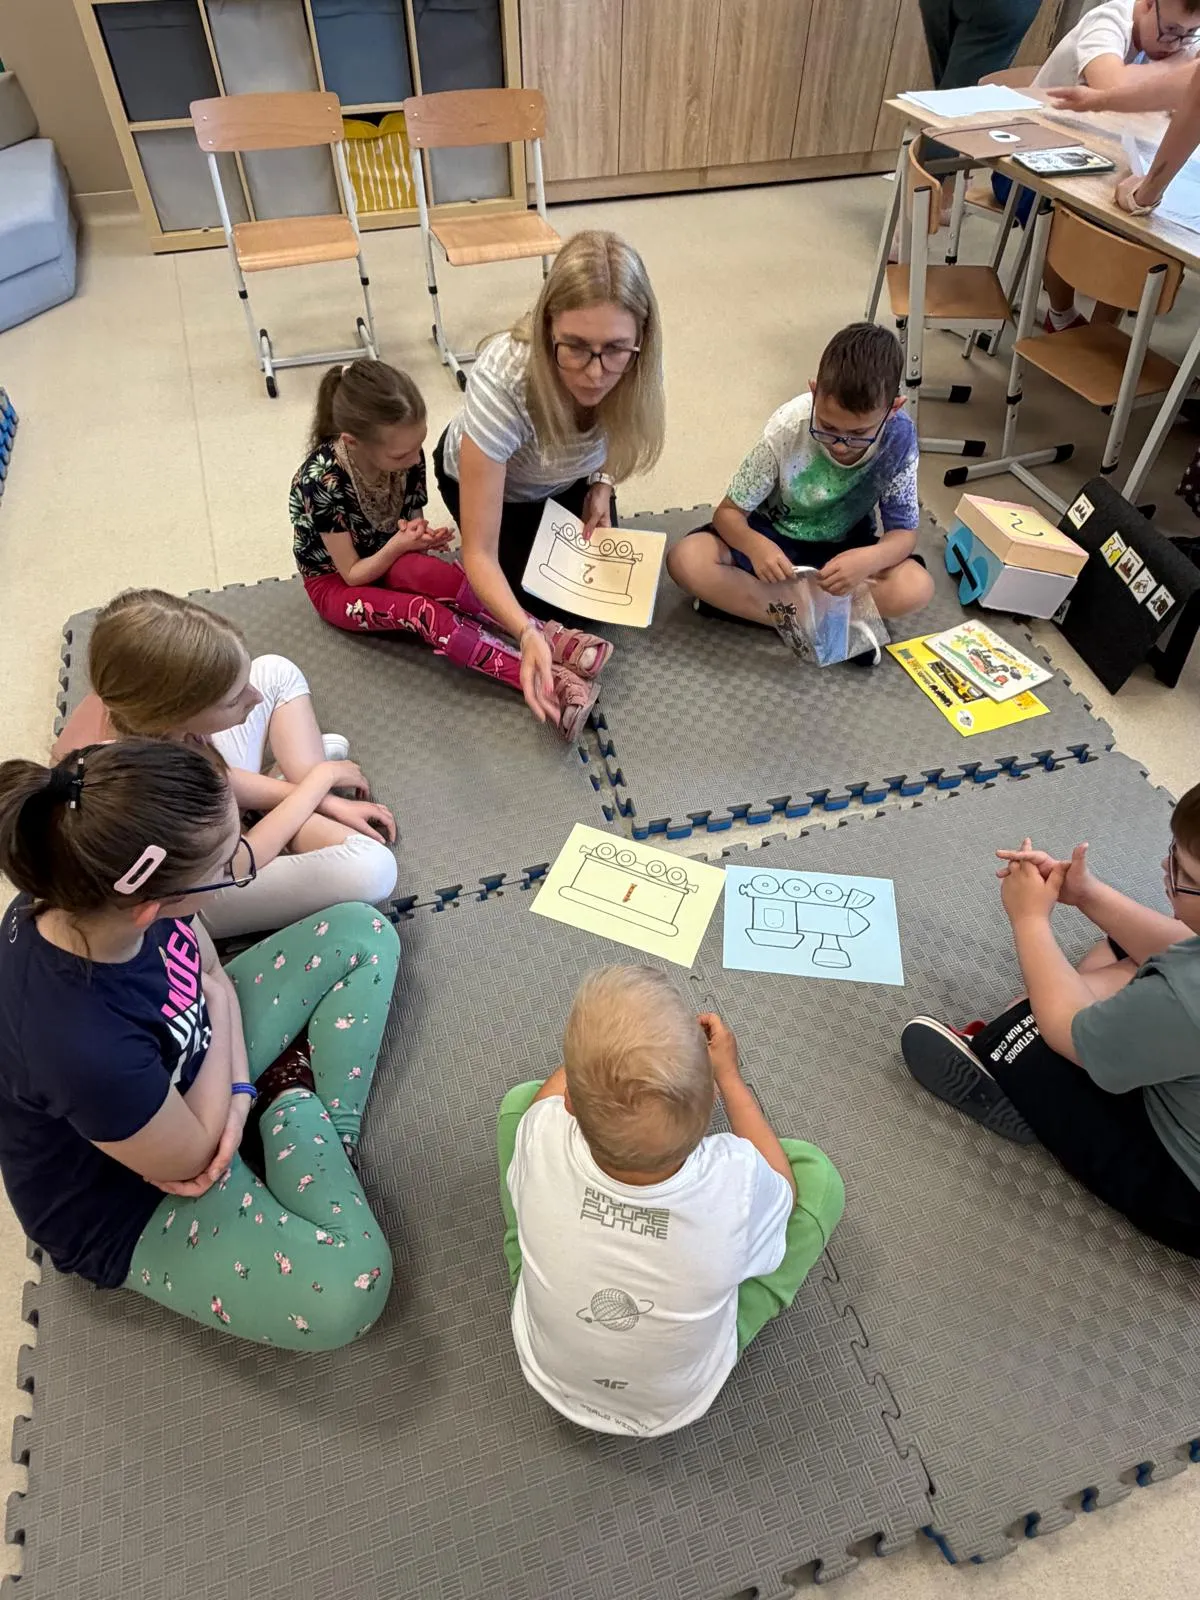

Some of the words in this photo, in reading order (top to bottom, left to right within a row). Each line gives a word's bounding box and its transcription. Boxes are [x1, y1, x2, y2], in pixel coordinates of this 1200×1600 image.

[1004, 1031, 1035, 1064] STUDIOS
[1005, 1023, 1023, 1043] RUN
[990, 1040, 1008, 1061] CLUB
[580, 1209, 668, 1240] FUTURE
[582, 1197, 670, 1228] FUTURE
